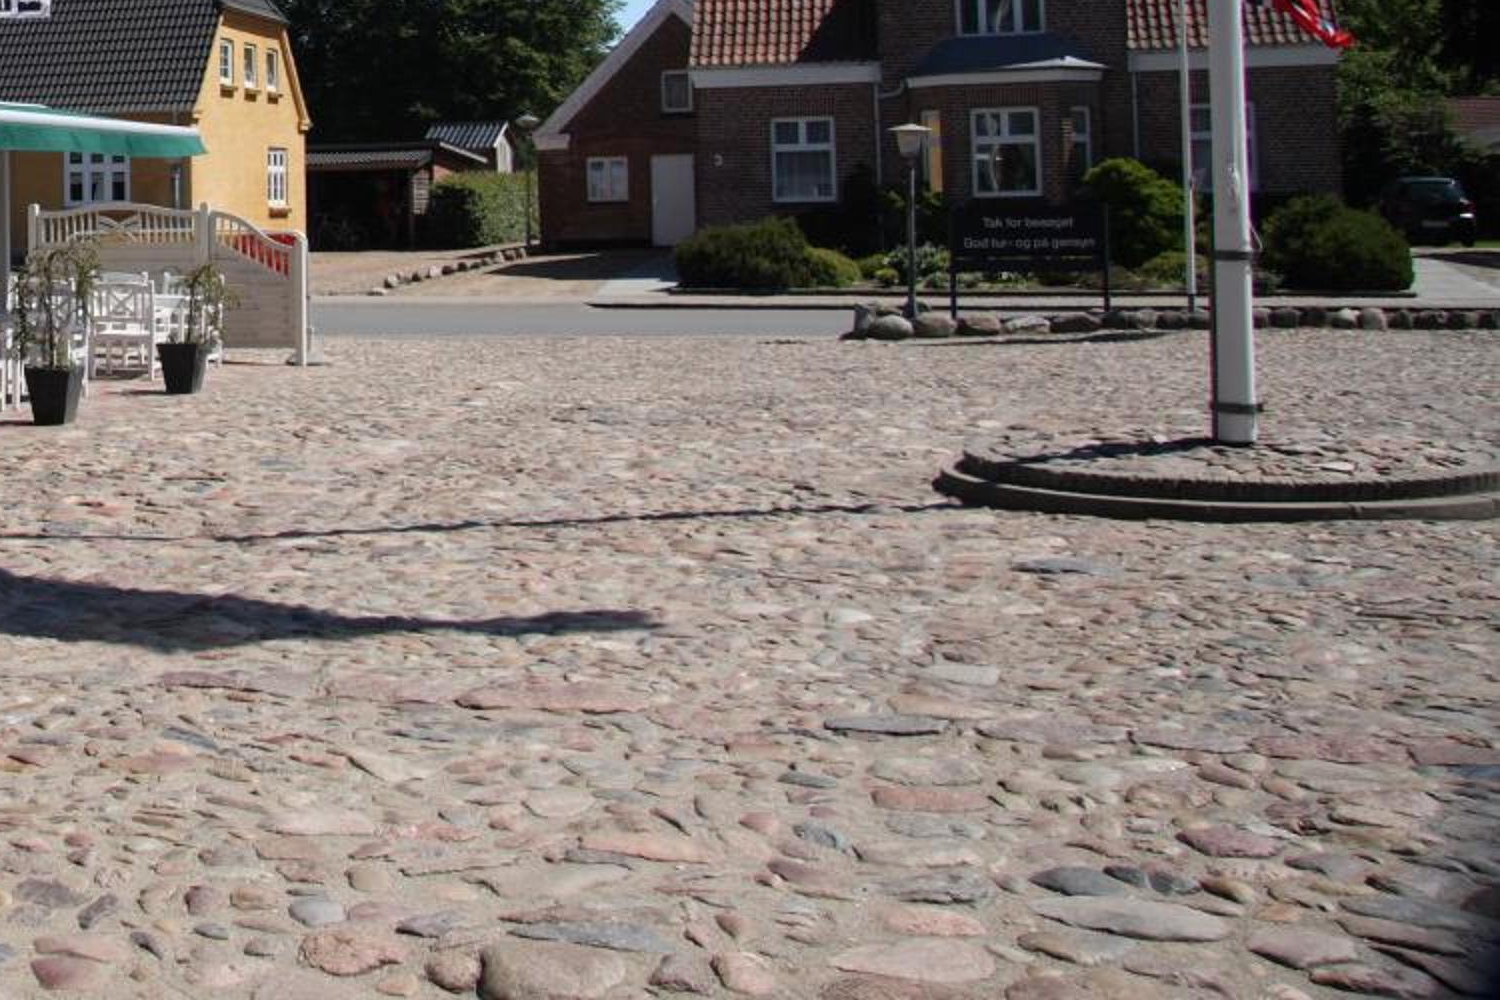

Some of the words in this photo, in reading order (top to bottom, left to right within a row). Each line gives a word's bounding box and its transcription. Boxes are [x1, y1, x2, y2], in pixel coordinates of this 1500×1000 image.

[982, 217, 1003, 229] Tak
[1005, 217, 1022, 229] for
[963, 237, 989, 249] God
[1015, 239, 1031, 249] og
